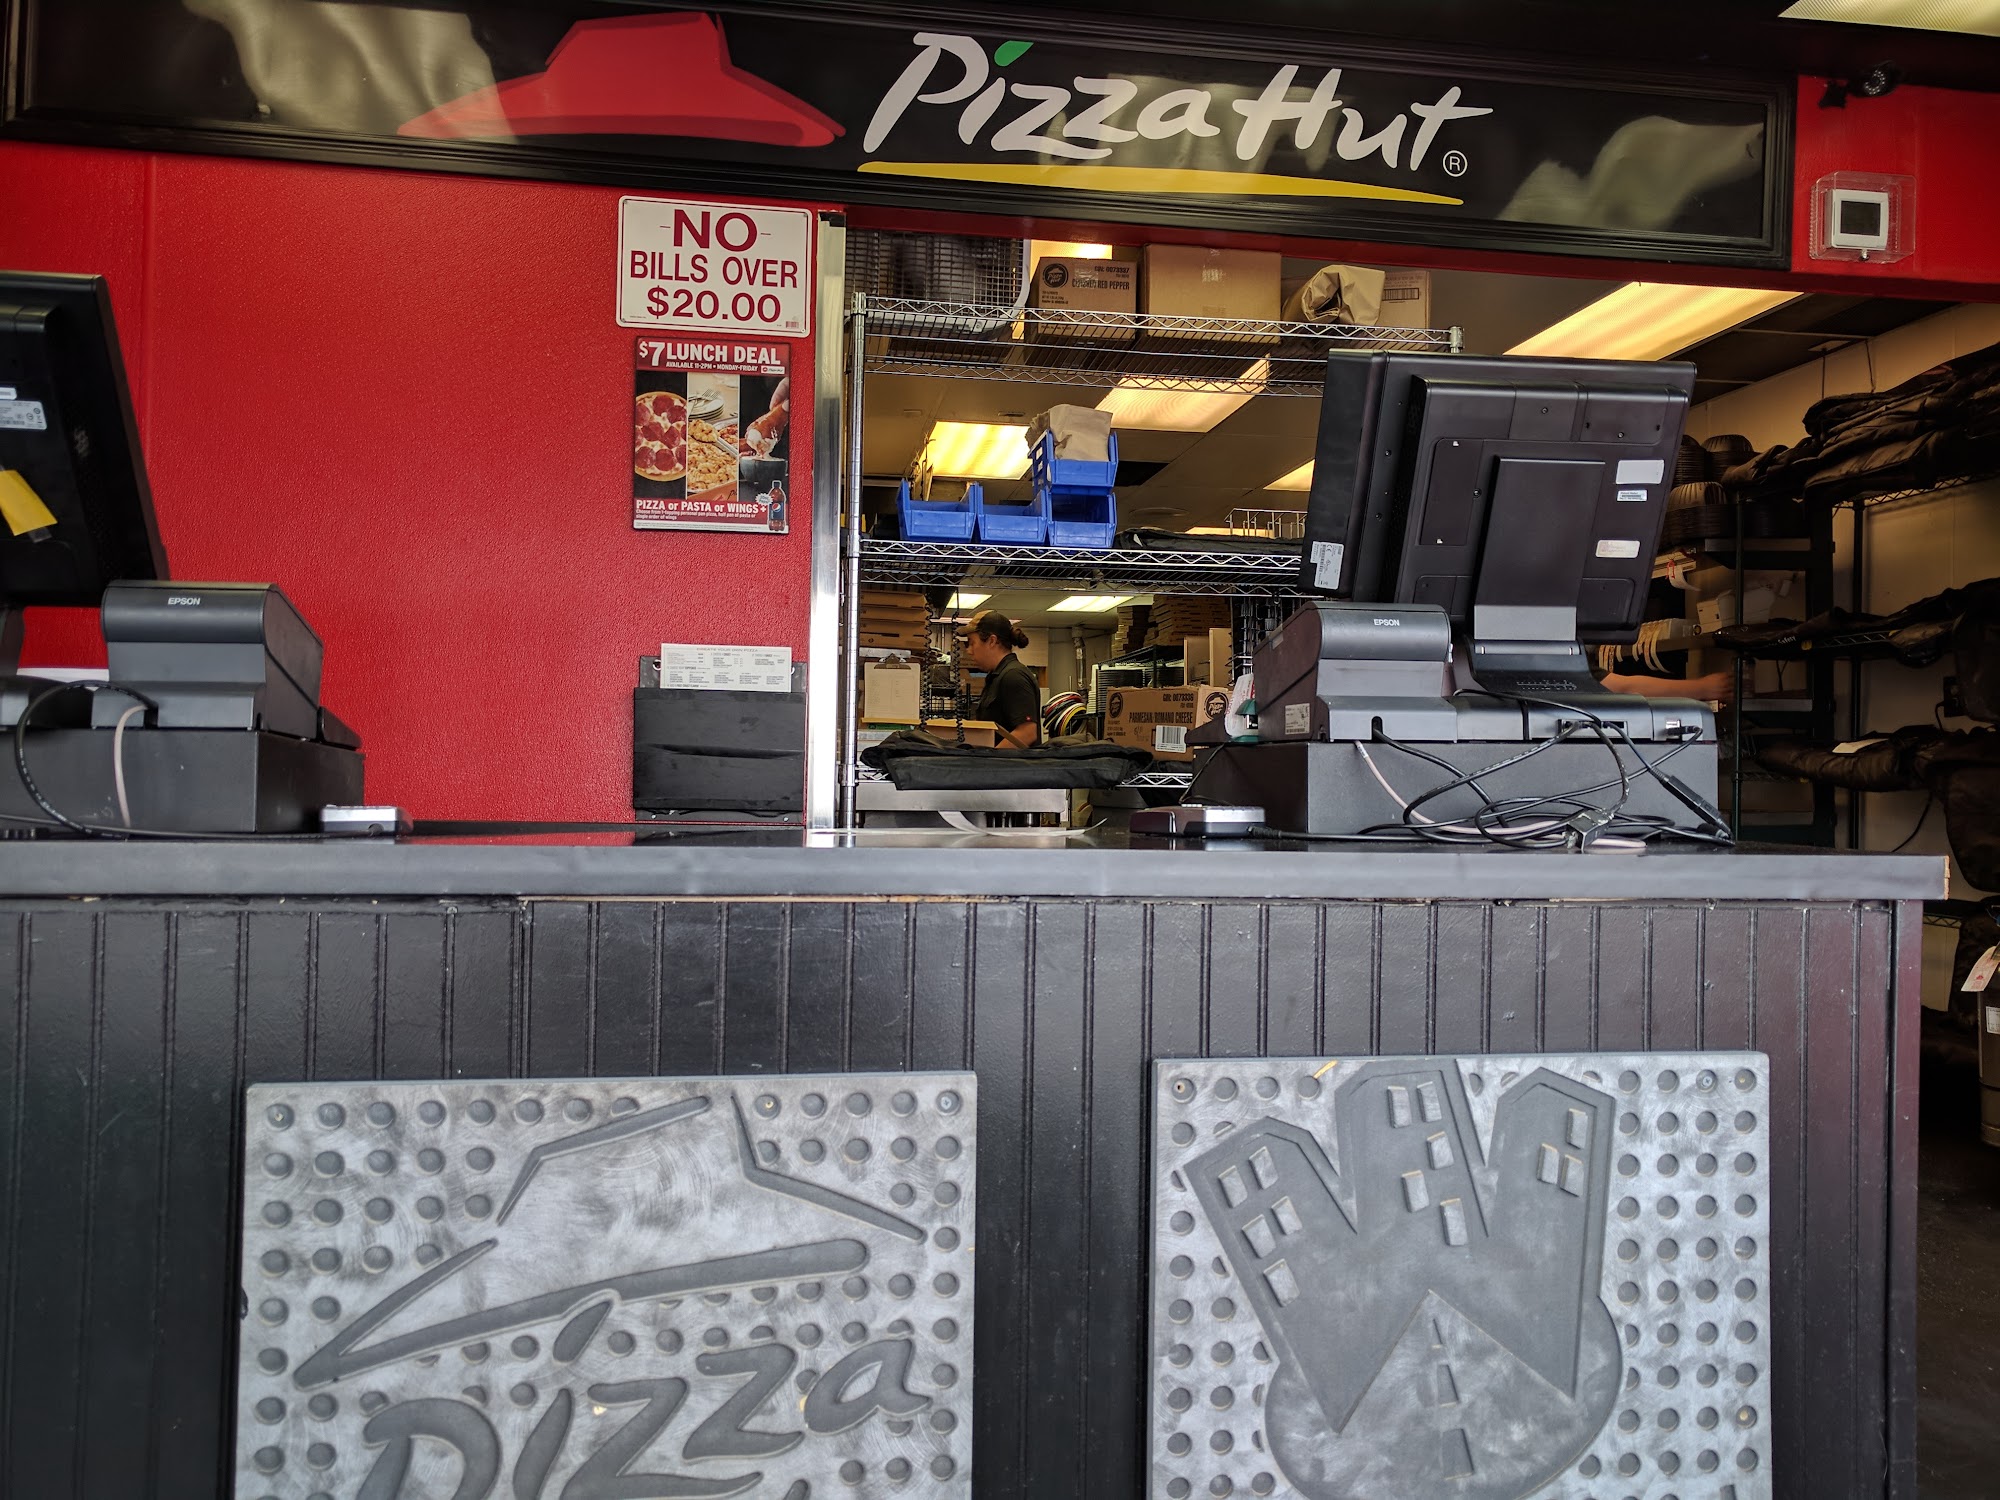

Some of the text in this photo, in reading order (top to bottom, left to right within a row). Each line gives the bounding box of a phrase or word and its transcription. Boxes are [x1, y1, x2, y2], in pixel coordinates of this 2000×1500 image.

[863, 32, 1221, 161] Pizza
[1232, 63, 1494, 172] Hut
[673, 208, 758, 252] NO
[630, 250, 798, 289] BILLS OVER
[1098, 280, 1108, 289] RED
[1110, 281, 1130, 290] PEPPER
[646, 285, 781, 323] $20.00
[639, 341, 781, 367] $7 LUNCH DEAL
[666, 361, 758, 372] AVAILABLE 11-2PM MONDAY-FRIDAY
[636, 499, 666, 511] PIZZA
[668, 502, 678, 511] or
[681, 502, 712, 512] PASTA
[714, 504, 725, 512] or
[727, 503, 759, 514] WINGS
[168, 597, 201, 606] EPSON
[1373, 618, 1400, 627] EPSON
[1175, 711, 1193, 723] CHEESE
